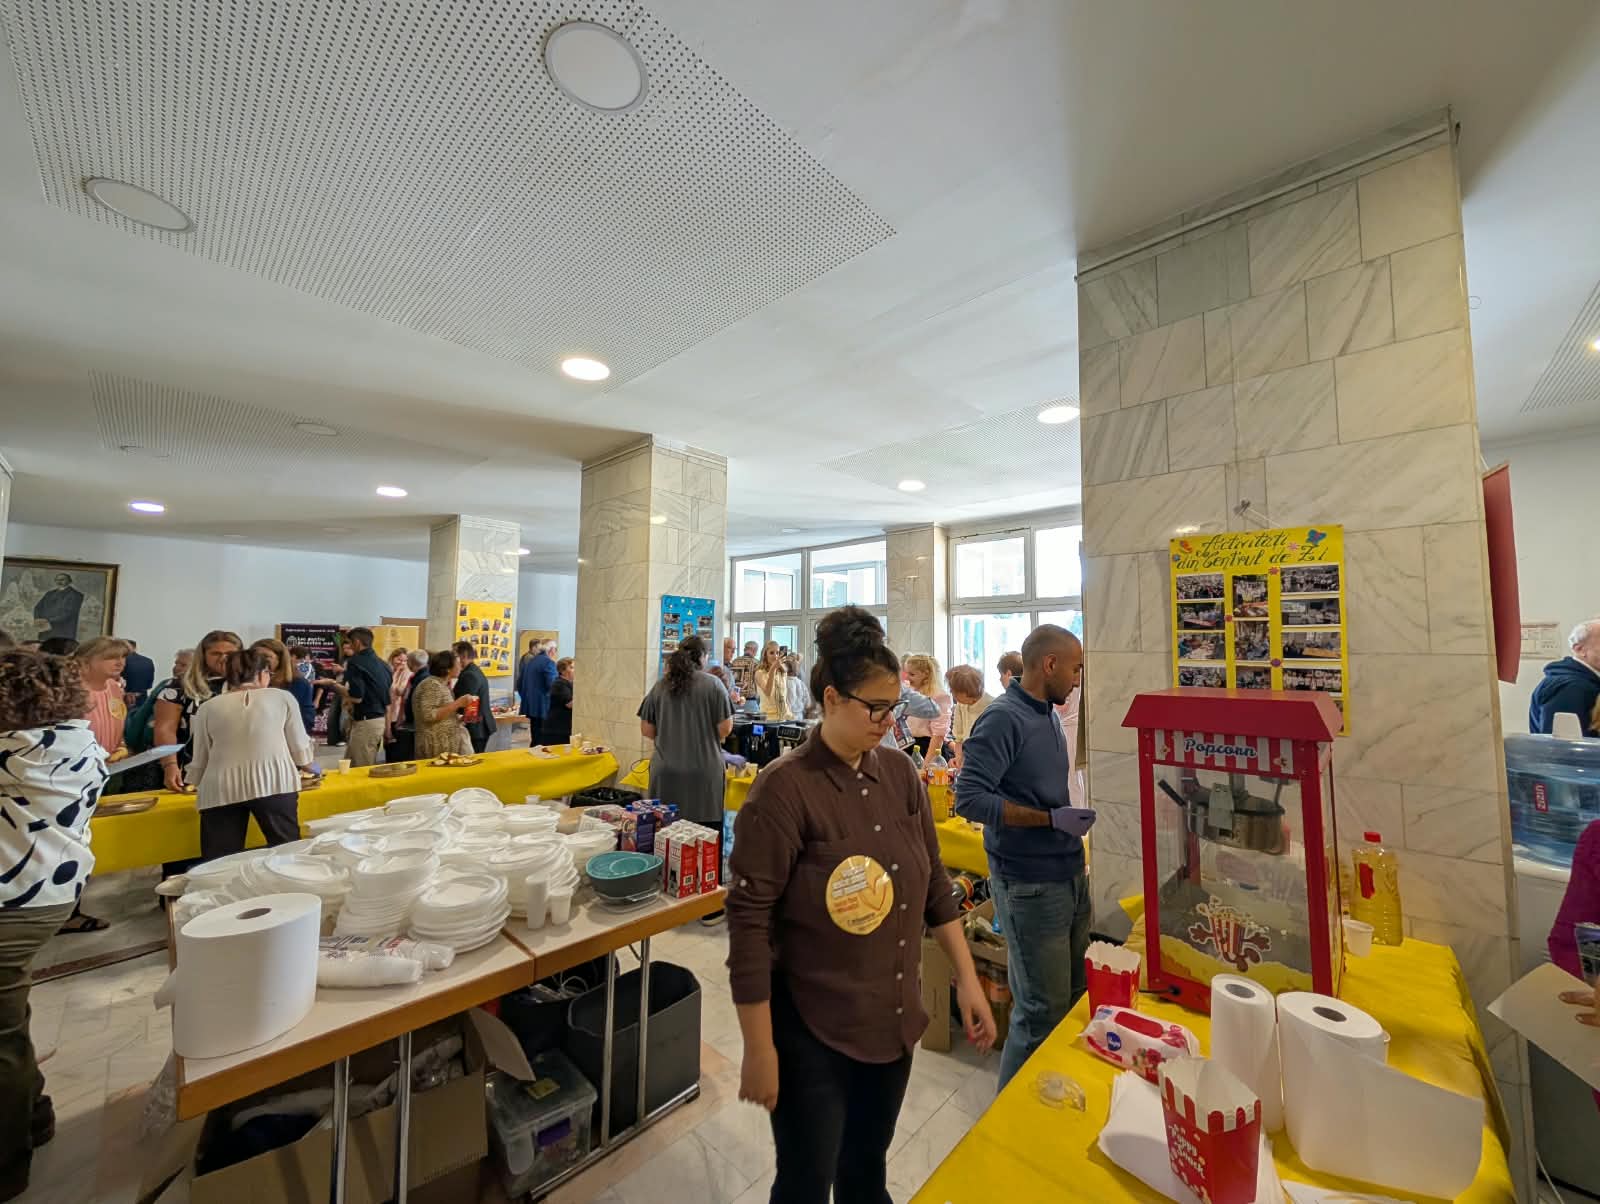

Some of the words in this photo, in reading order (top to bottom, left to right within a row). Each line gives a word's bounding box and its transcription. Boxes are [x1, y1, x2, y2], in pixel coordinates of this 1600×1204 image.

[1176, 557, 1200, 571] din
[1269, 550, 1291, 564] de
[1184, 738, 1257, 757] Popcorn
